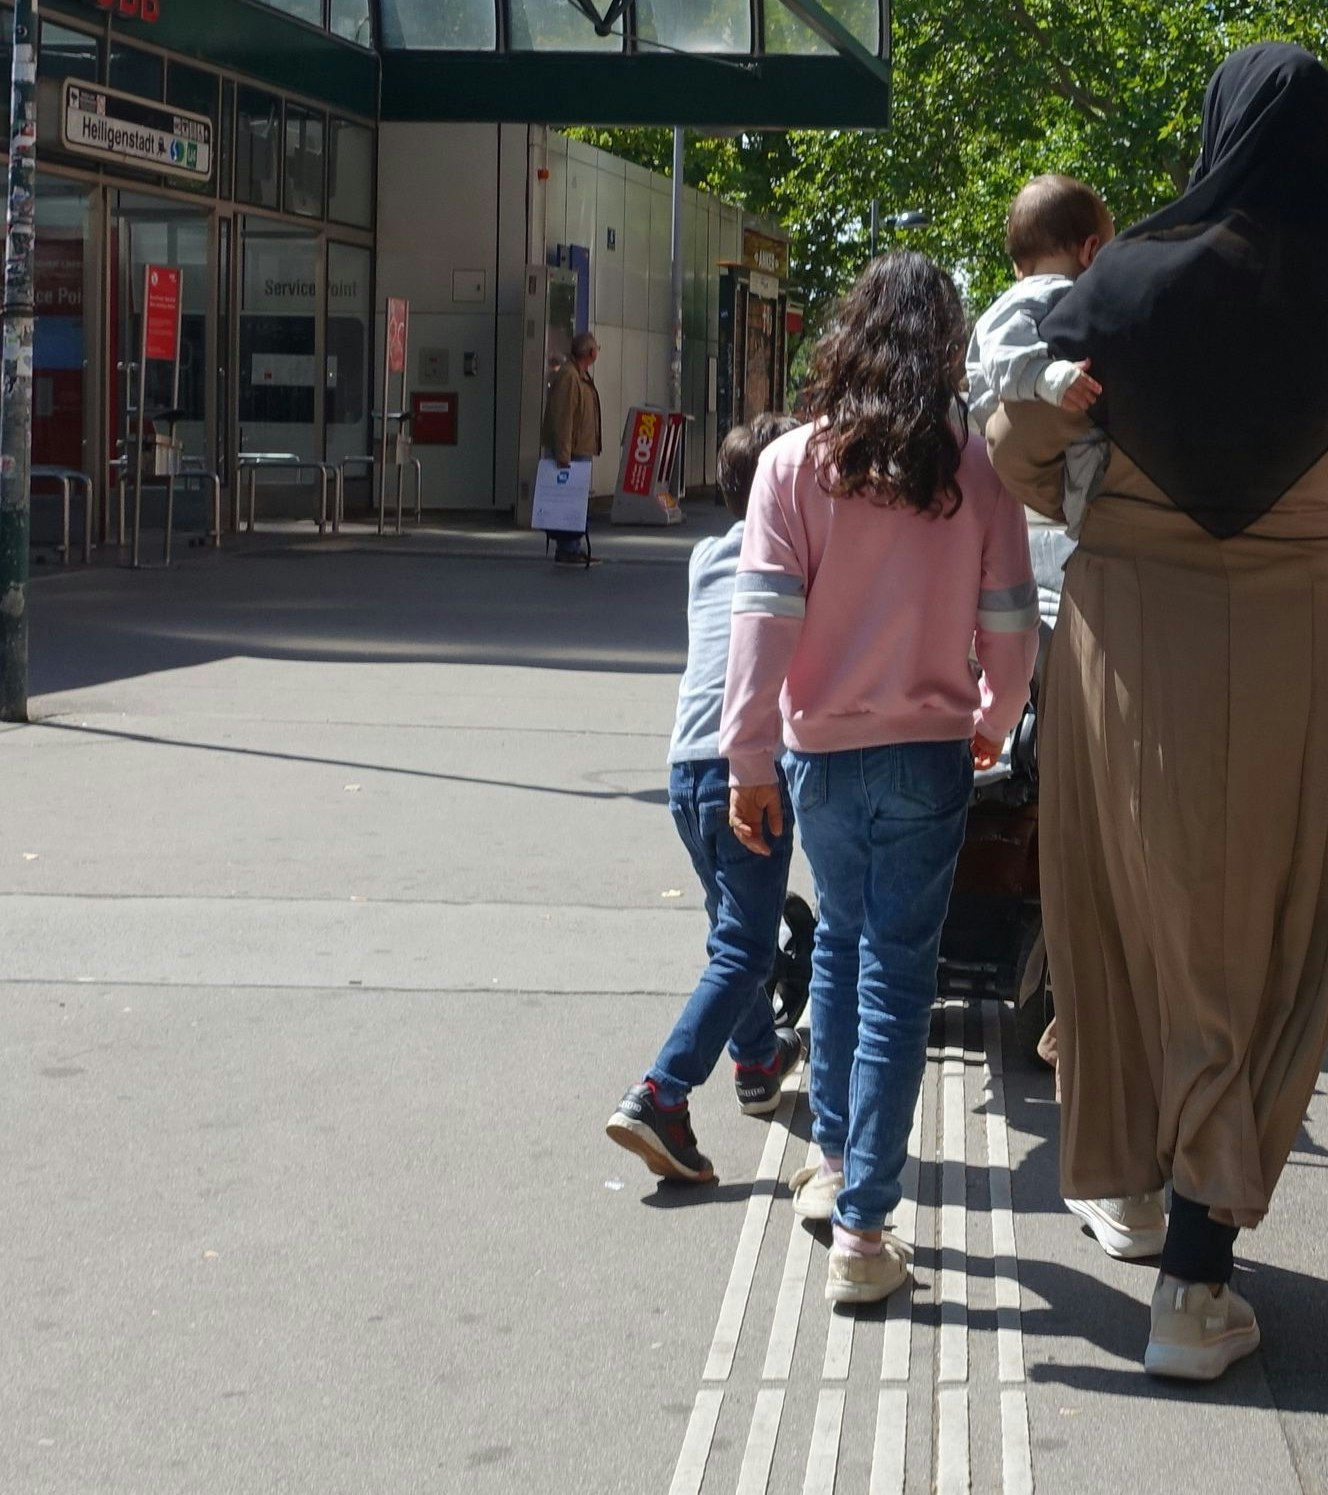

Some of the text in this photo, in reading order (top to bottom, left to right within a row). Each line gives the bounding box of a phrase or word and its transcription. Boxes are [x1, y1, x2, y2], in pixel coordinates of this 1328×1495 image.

[82, 115, 154, 153] Heiligenstadt
[58, 287, 82, 304] Poi
[264, 279, 358, 297] Service oint
